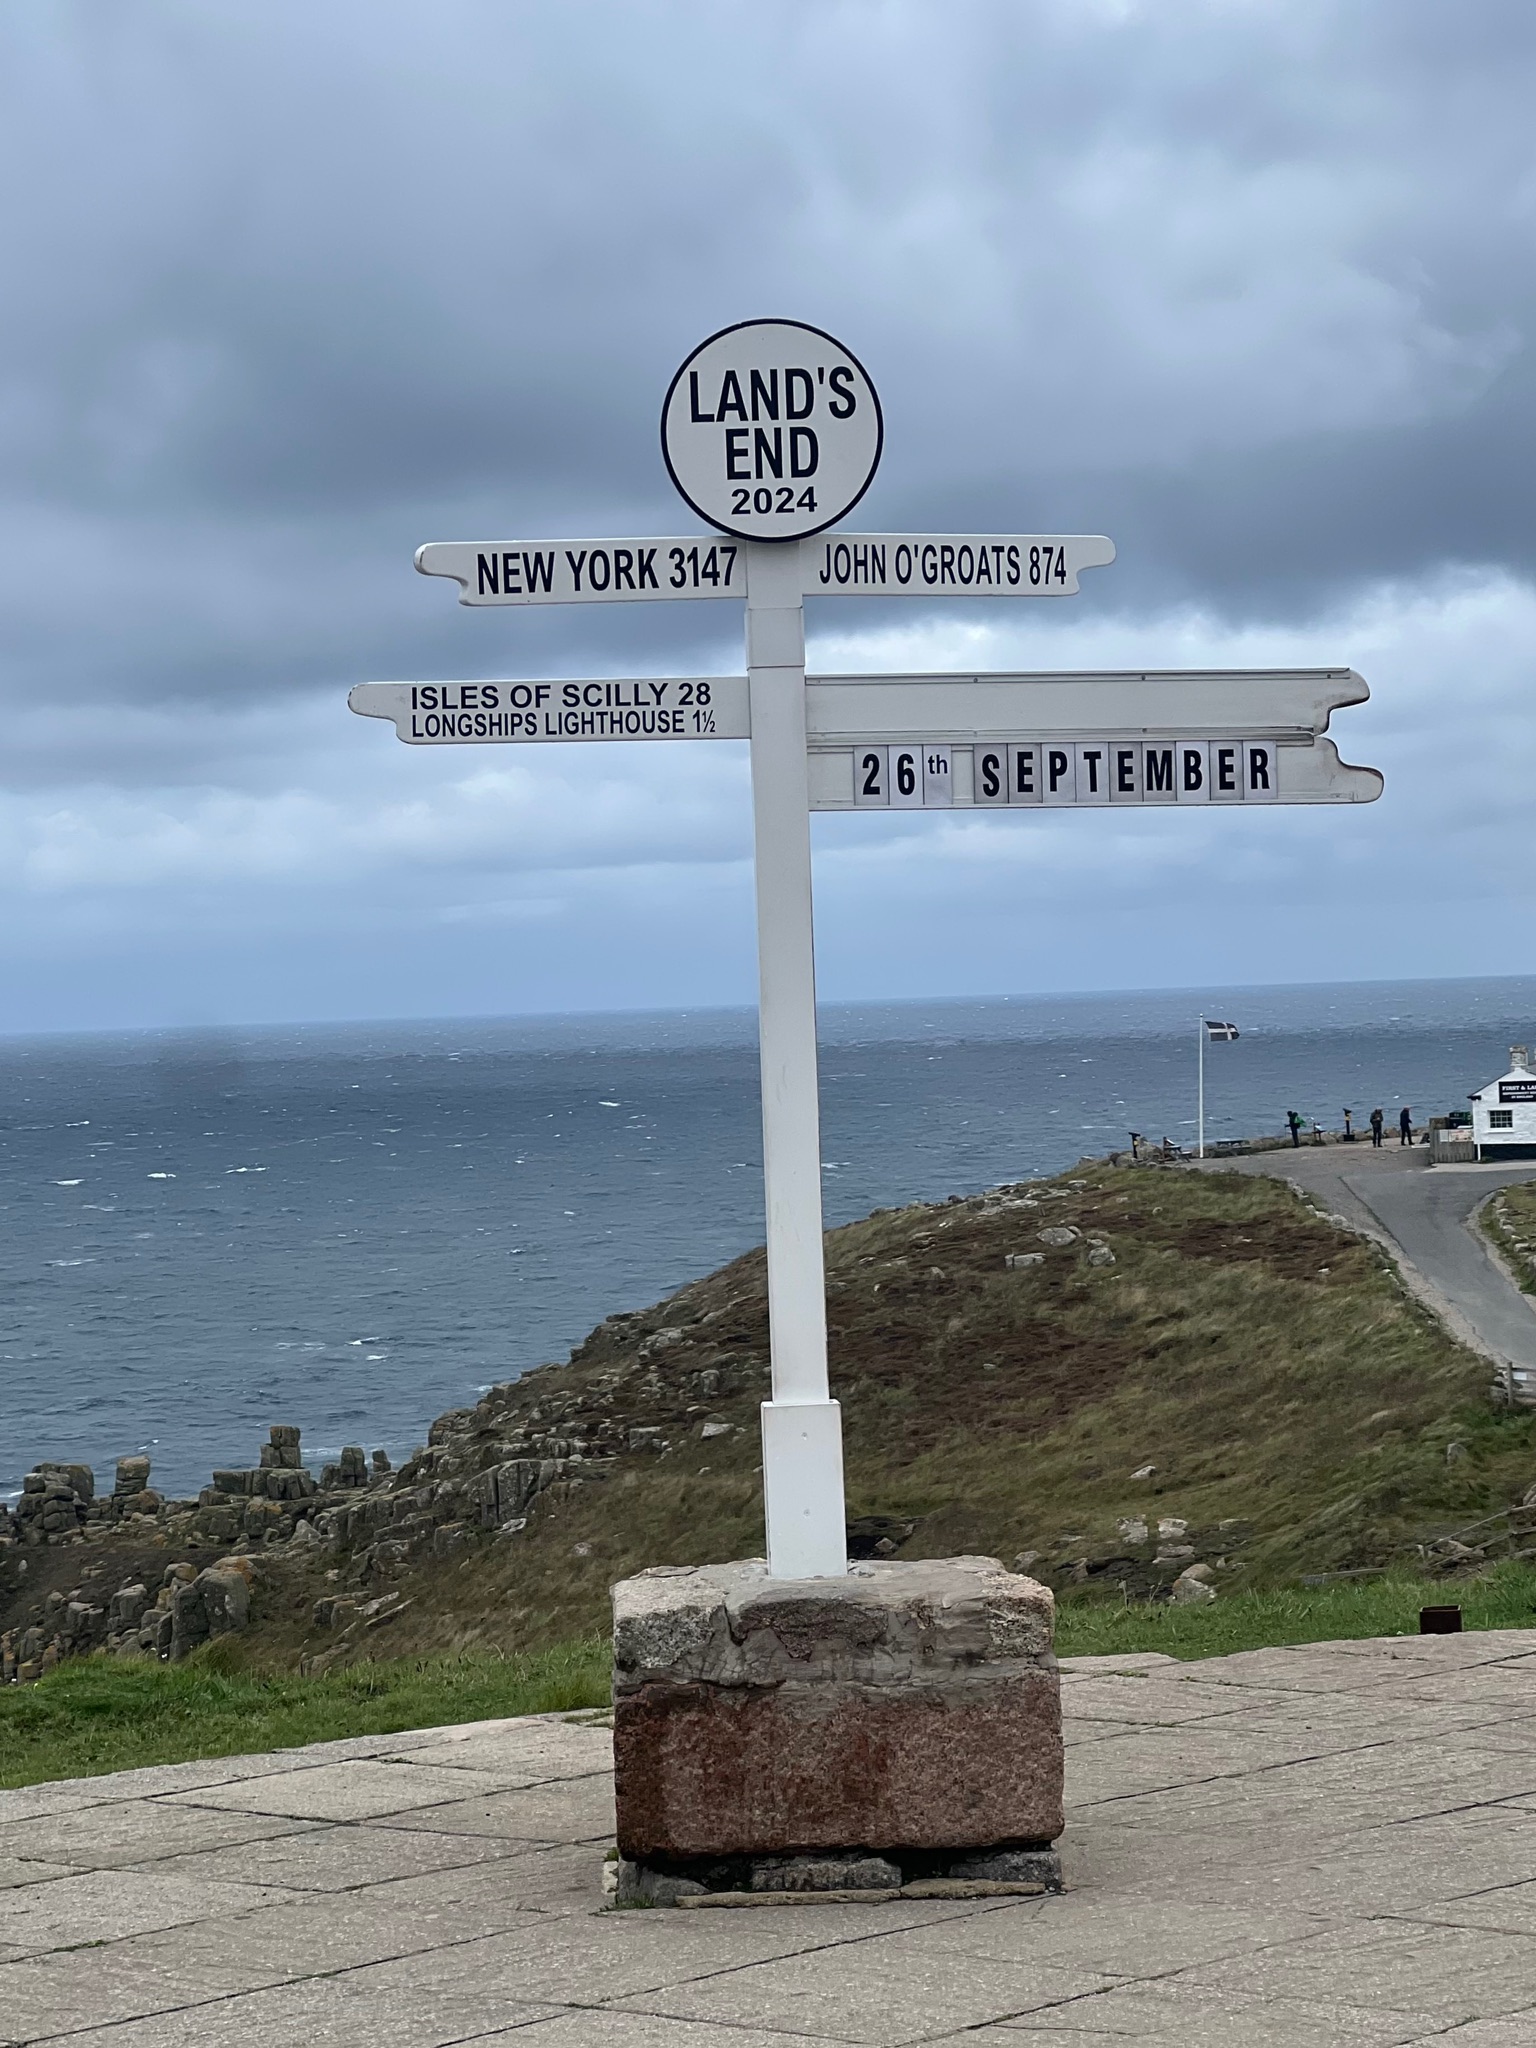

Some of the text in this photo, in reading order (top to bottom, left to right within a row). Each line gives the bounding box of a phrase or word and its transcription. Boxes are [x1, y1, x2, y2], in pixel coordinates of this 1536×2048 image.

[689, 366, 857, 424] LAND'S
[725, 426, 819, 481] END
[731, 486, 818, 515] 2024
[477, 545, 738, 595] NEW YORK 3147
[819, 543, 1067, 586] JOHN O'GROATS 874
[411, 682, 711, 710] ISLES OF SCILLY 28
[412, 712, 538, 738] LONGSHIPS
[545, 709, 685, 736] LIGHTHOUSE
[981, 748, 1270, 798] SEPTEMBER
